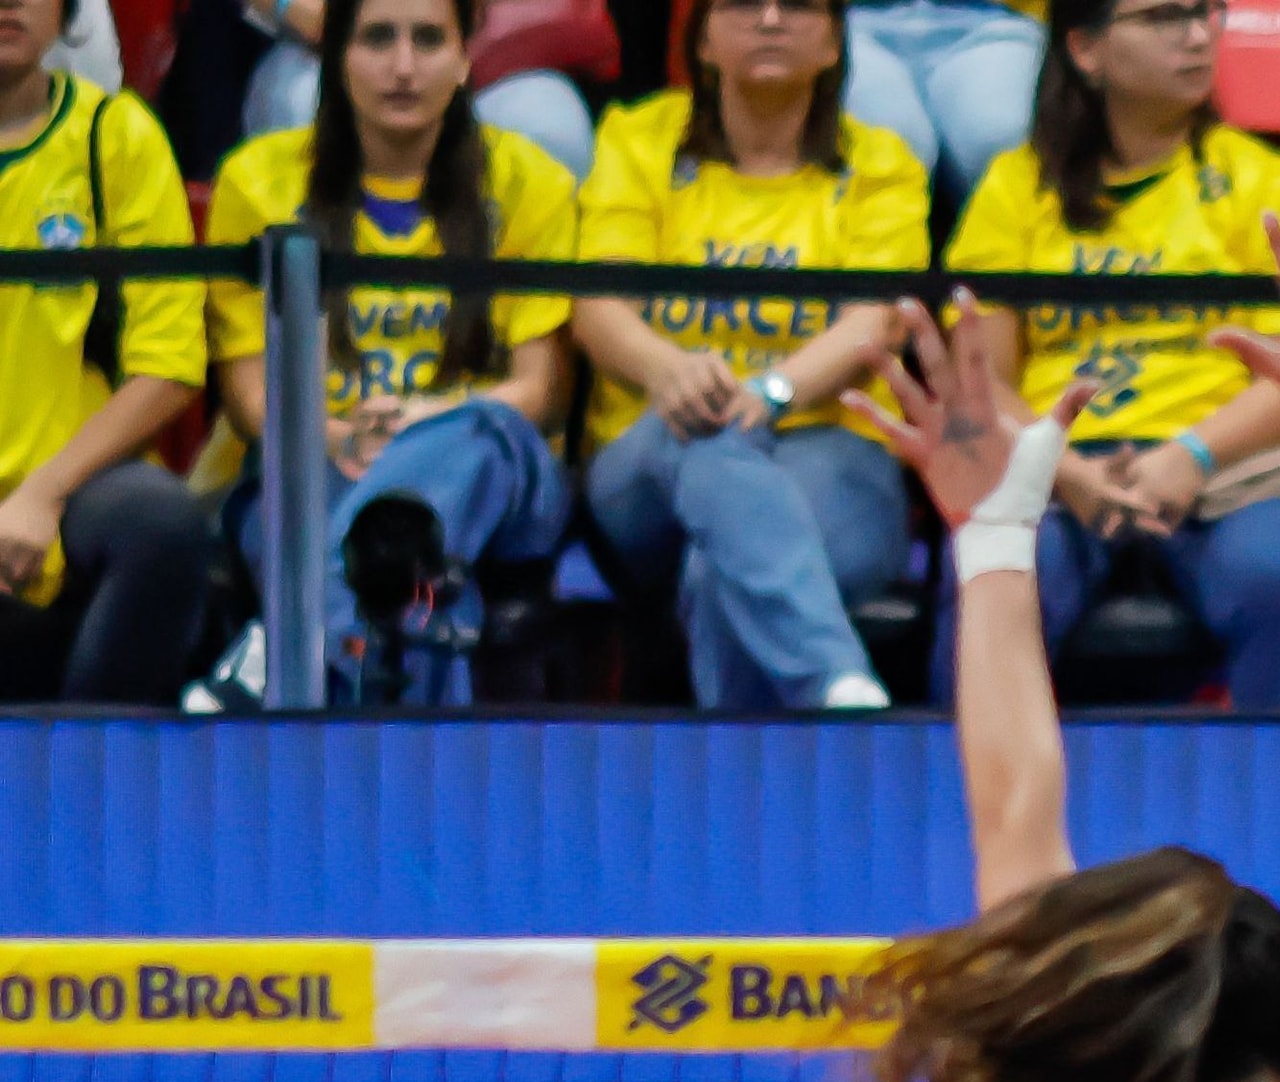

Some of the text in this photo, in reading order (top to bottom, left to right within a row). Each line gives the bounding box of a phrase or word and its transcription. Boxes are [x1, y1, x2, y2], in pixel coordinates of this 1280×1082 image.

[49, 975, 126, 1021] DO
[138, 964, 342, 1020] BRASIL
[730, 966, 868, 1019] BAN
